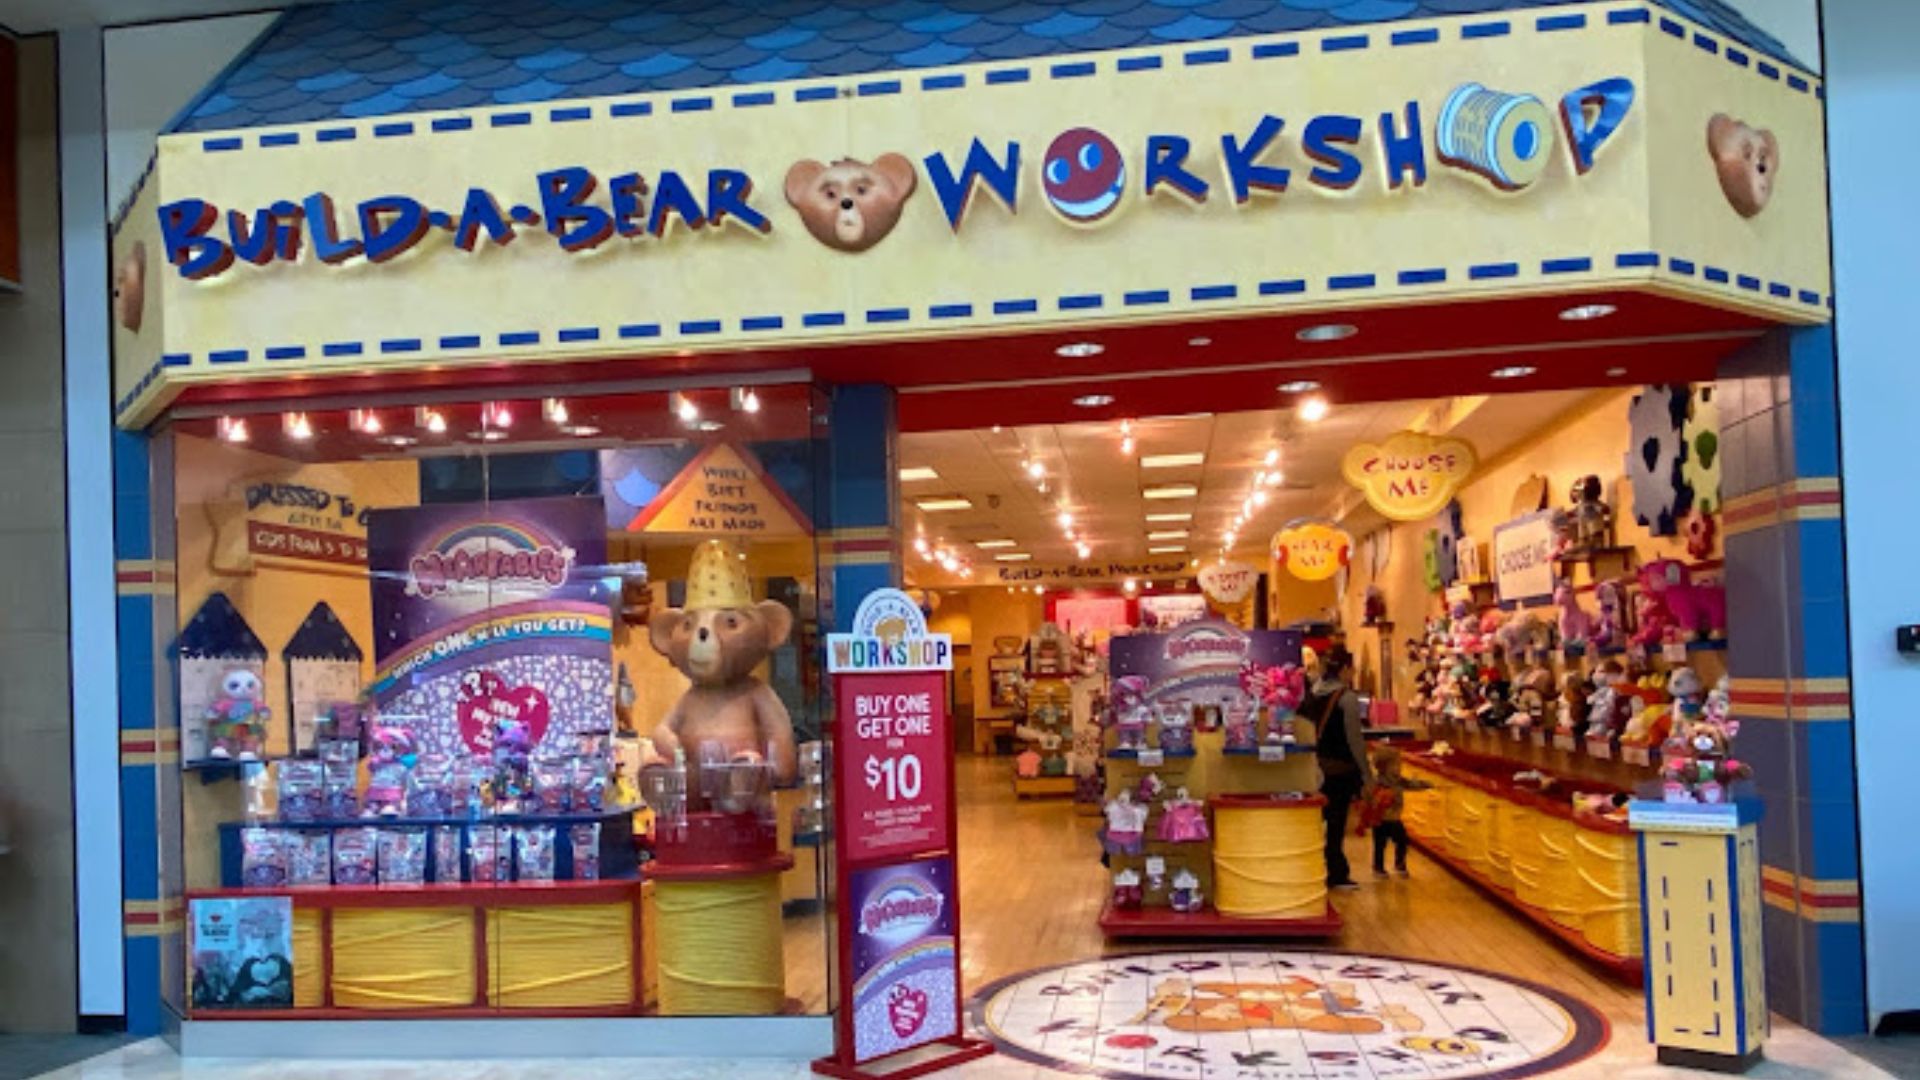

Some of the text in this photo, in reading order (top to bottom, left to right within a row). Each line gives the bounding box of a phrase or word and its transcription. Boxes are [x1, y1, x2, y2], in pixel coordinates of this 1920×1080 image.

[923, 76, 1636, 234] WORKSHOP
[1362, 453, 1456, 473] CHOOSE
[1389, 477, 1429, 498] ME
[513, 619, 544, 634] YOU
[833, 640, 947, 668] WORKSHOP
[855, 692, 931, 716] BUY ONE
[857, 715, 932, 738] GET ONE
[864, 754, 921, 801] $10
